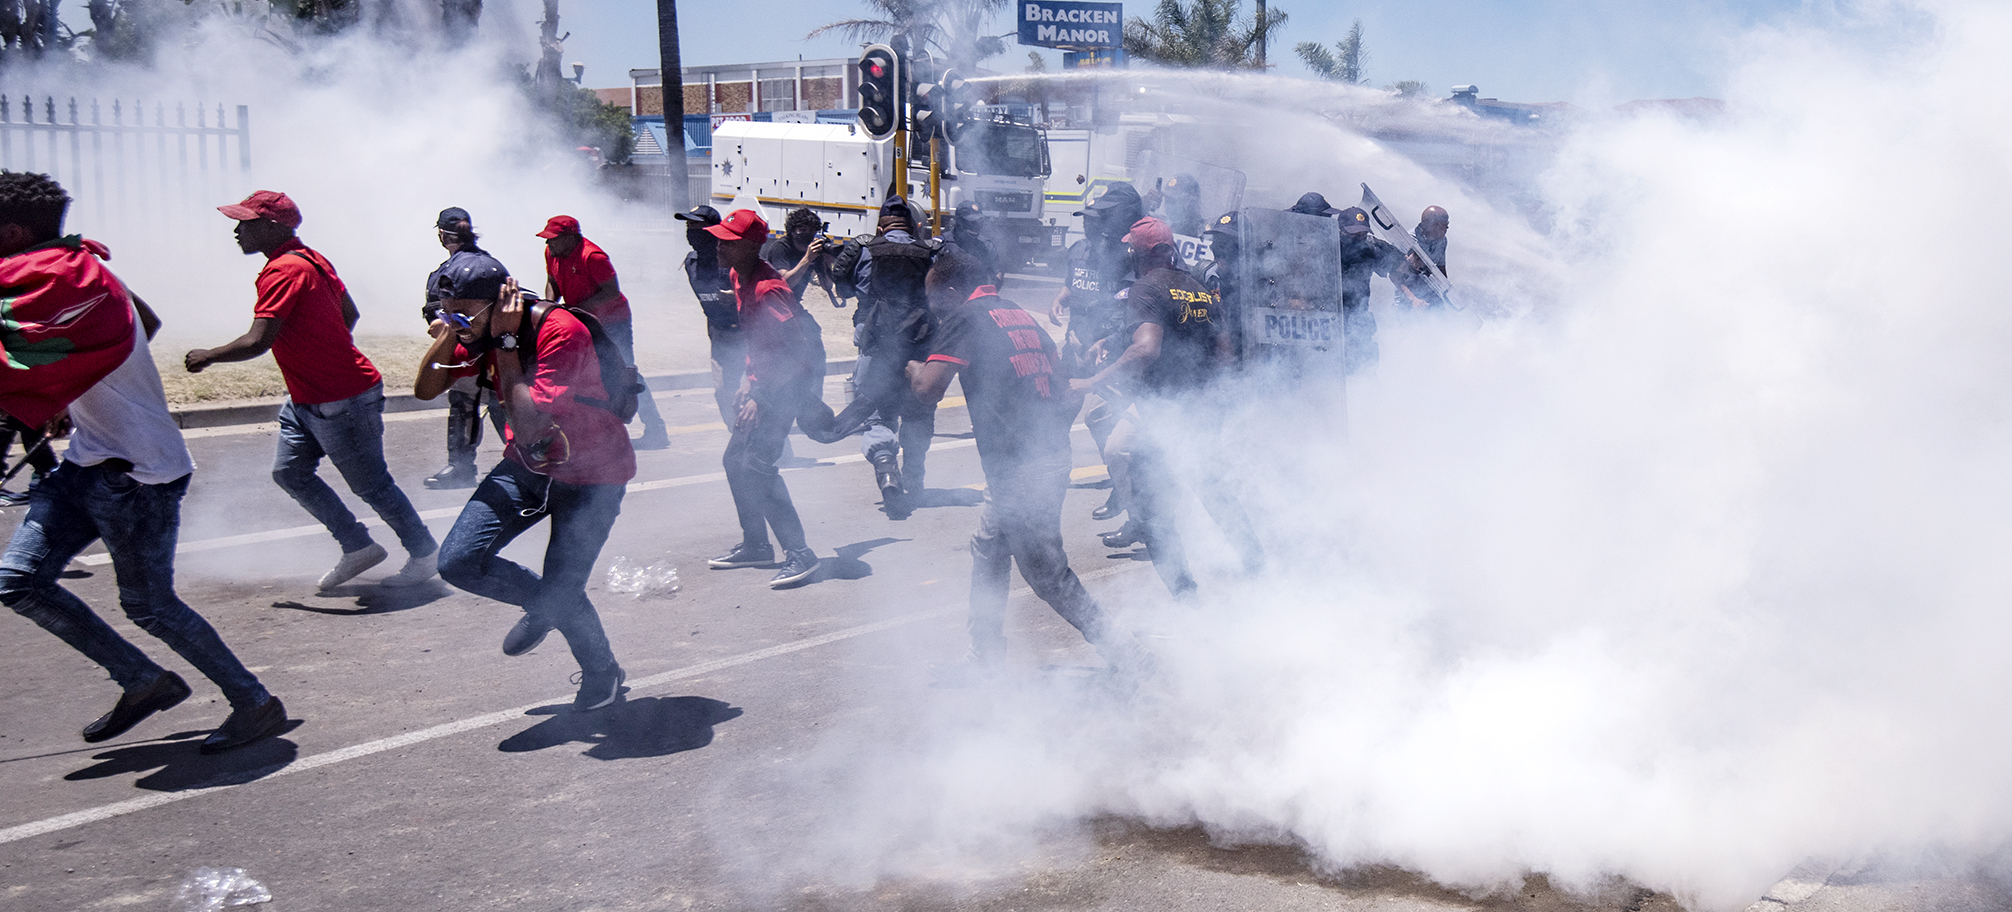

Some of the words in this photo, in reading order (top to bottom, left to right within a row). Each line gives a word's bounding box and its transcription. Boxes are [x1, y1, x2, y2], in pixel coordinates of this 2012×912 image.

[1025, 4, 1117, 24] BRACKEN
[1037, 25, 1110, 43] MANOR
[1176, 239, 1208, 261] ICE
[1072, 278, 1100, 291] POLICE
[1169, 288, 1212, 305] SOCALIST
[1265, 314, 1331, 341] POLICE
